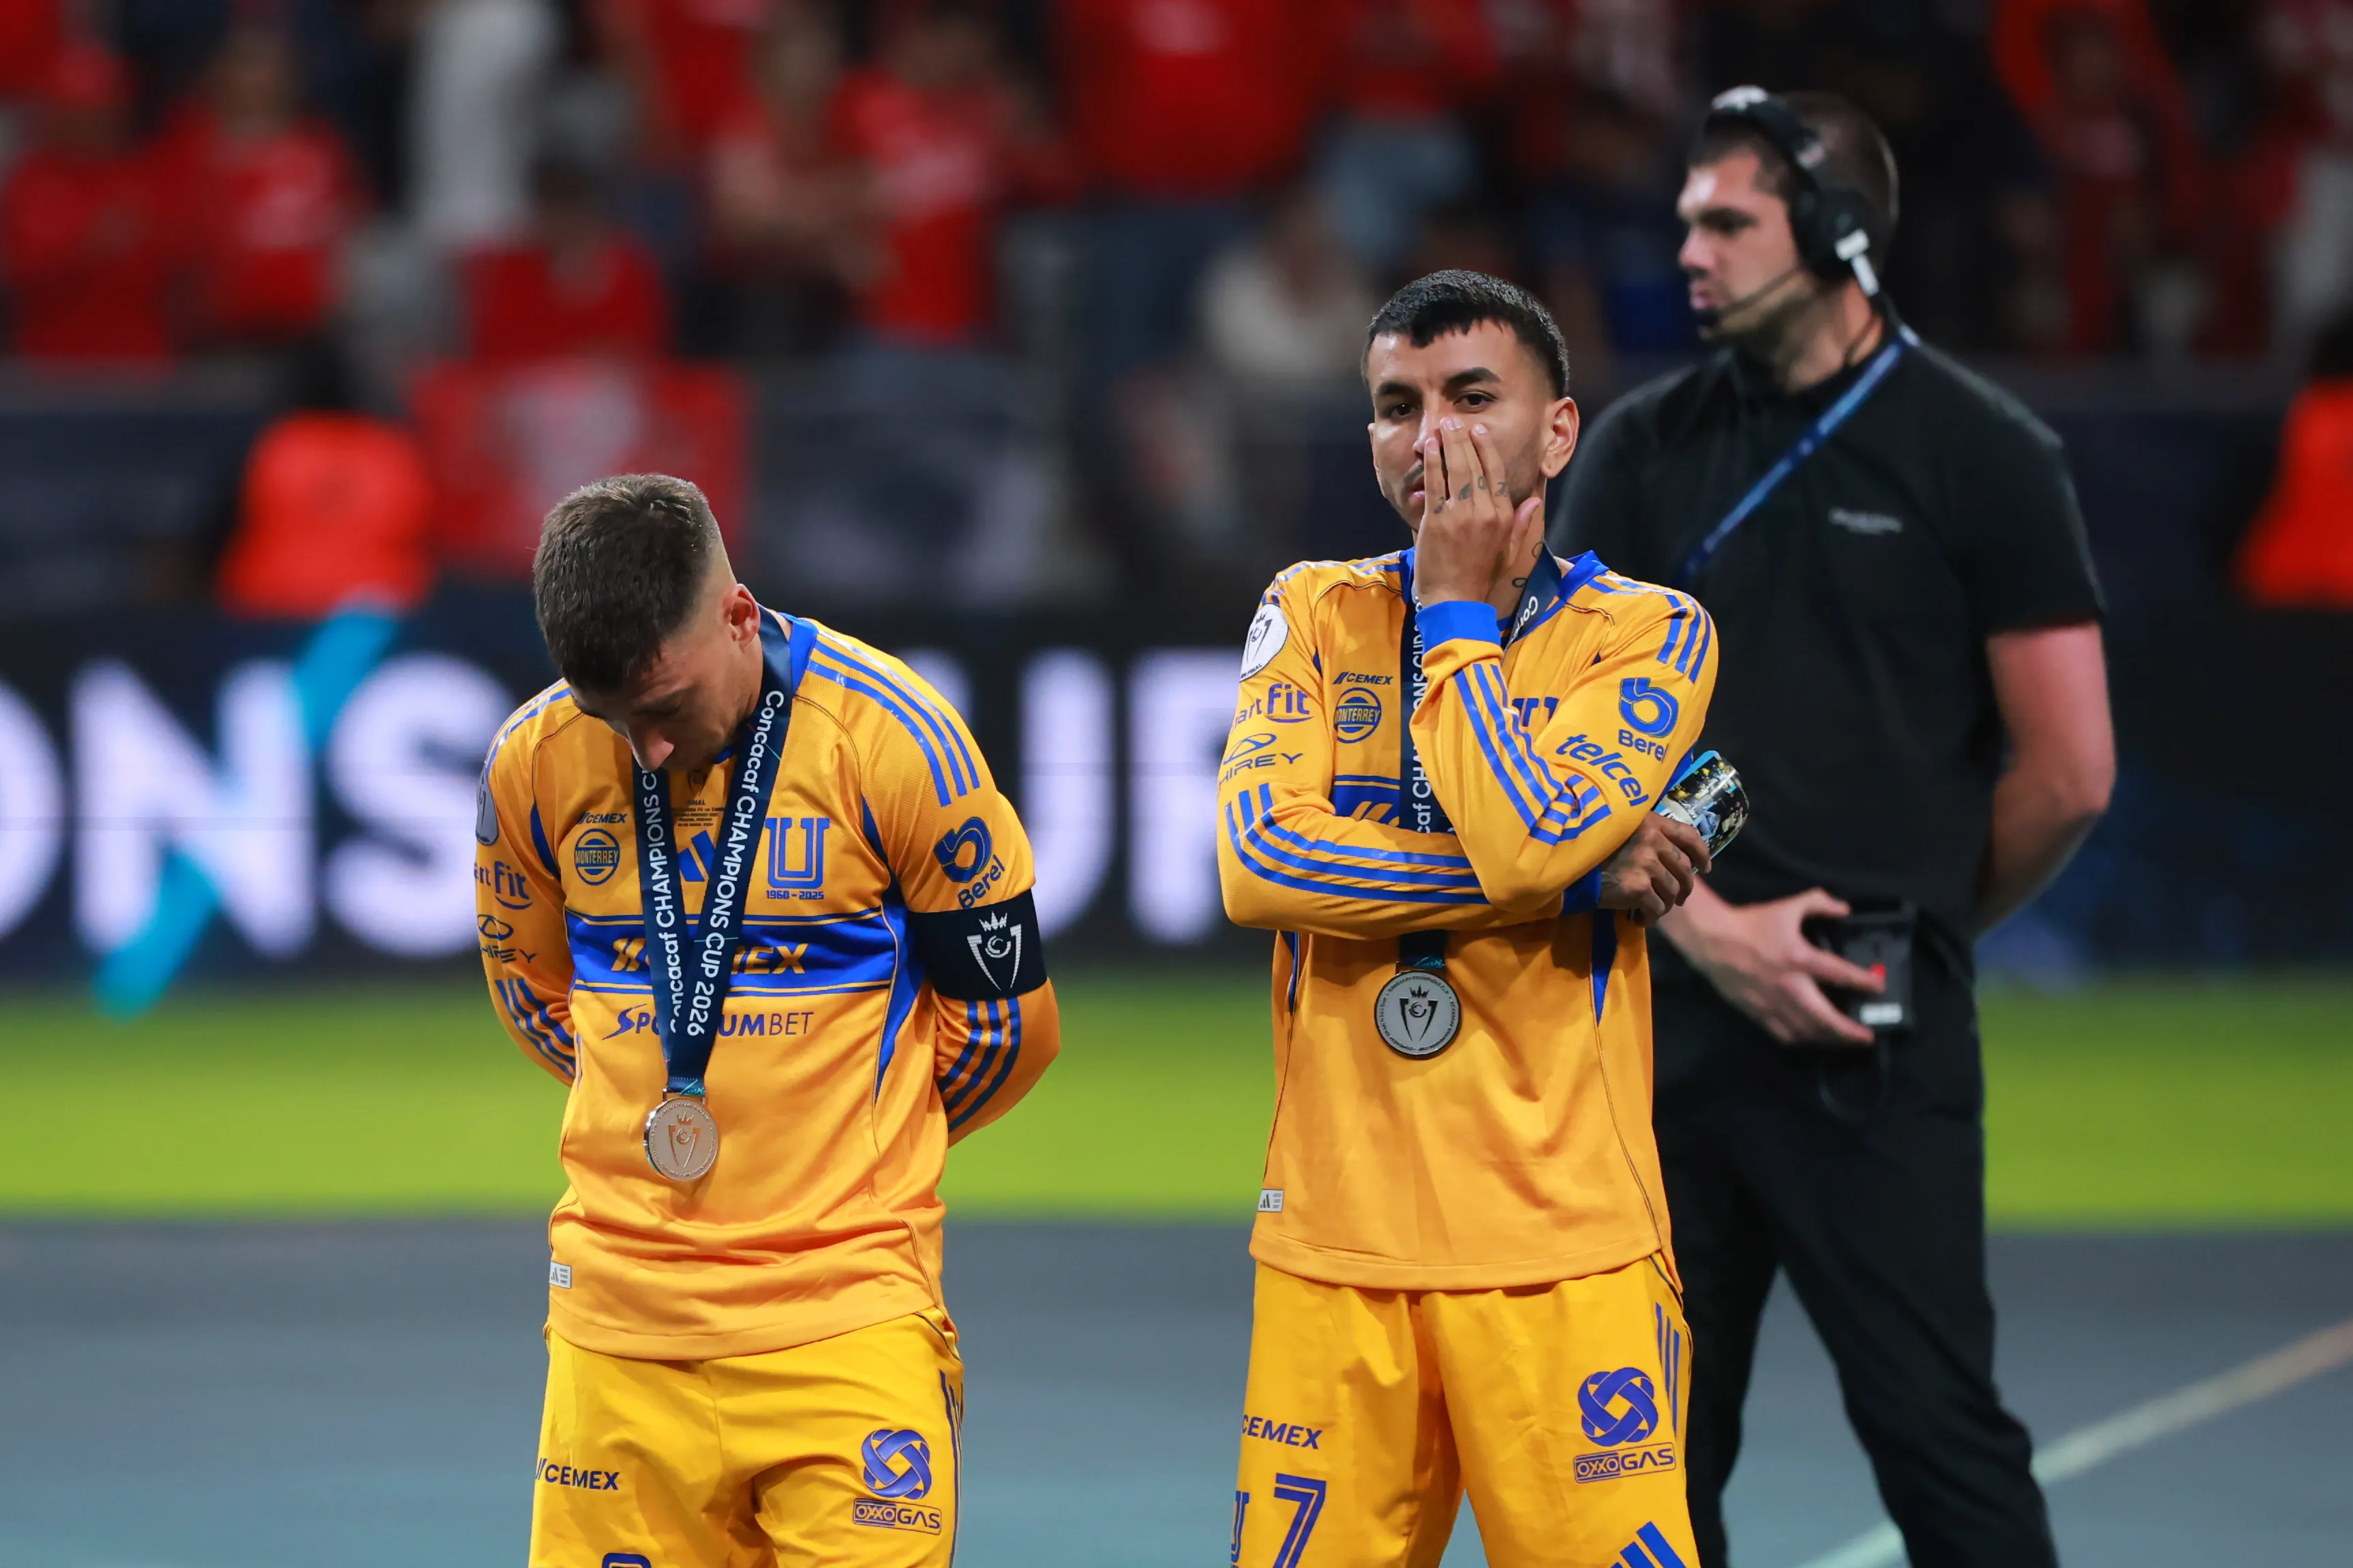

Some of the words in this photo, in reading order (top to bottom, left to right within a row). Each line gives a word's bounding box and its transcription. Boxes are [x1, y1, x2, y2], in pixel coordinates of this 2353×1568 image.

[1347, 673, 1393, 685] CEMEX
[1268, 683, 1309, 715] fit
[742, 690, 785, 793] Concacaf
[1618, 729, 1669, 763] Berel
[1556, 734, 1649, 807] telcel
[586, 812, 628, 824] CEMEX
[575, 850, 619, 864] MONTERREY
[643, 795, 675, 928] CHAMPIONS
[710, 796, 756, 929] CHAMPIONS
[494, 861, 530, 900] fit
[957, 855, 1005, 909] Berel
[701, 932, 725, 978] CUP
[687, 981, 714, 1036] 2026
[1242, 1415, 1323, 1449] CEMEX
[545, 1464, 620, 1490] CEMEX
[1621, 1448, 1674, 1470] GAS
[898, 1508, 941, 1528] GAS
[1273, 1473, 1326, 1568] 7
